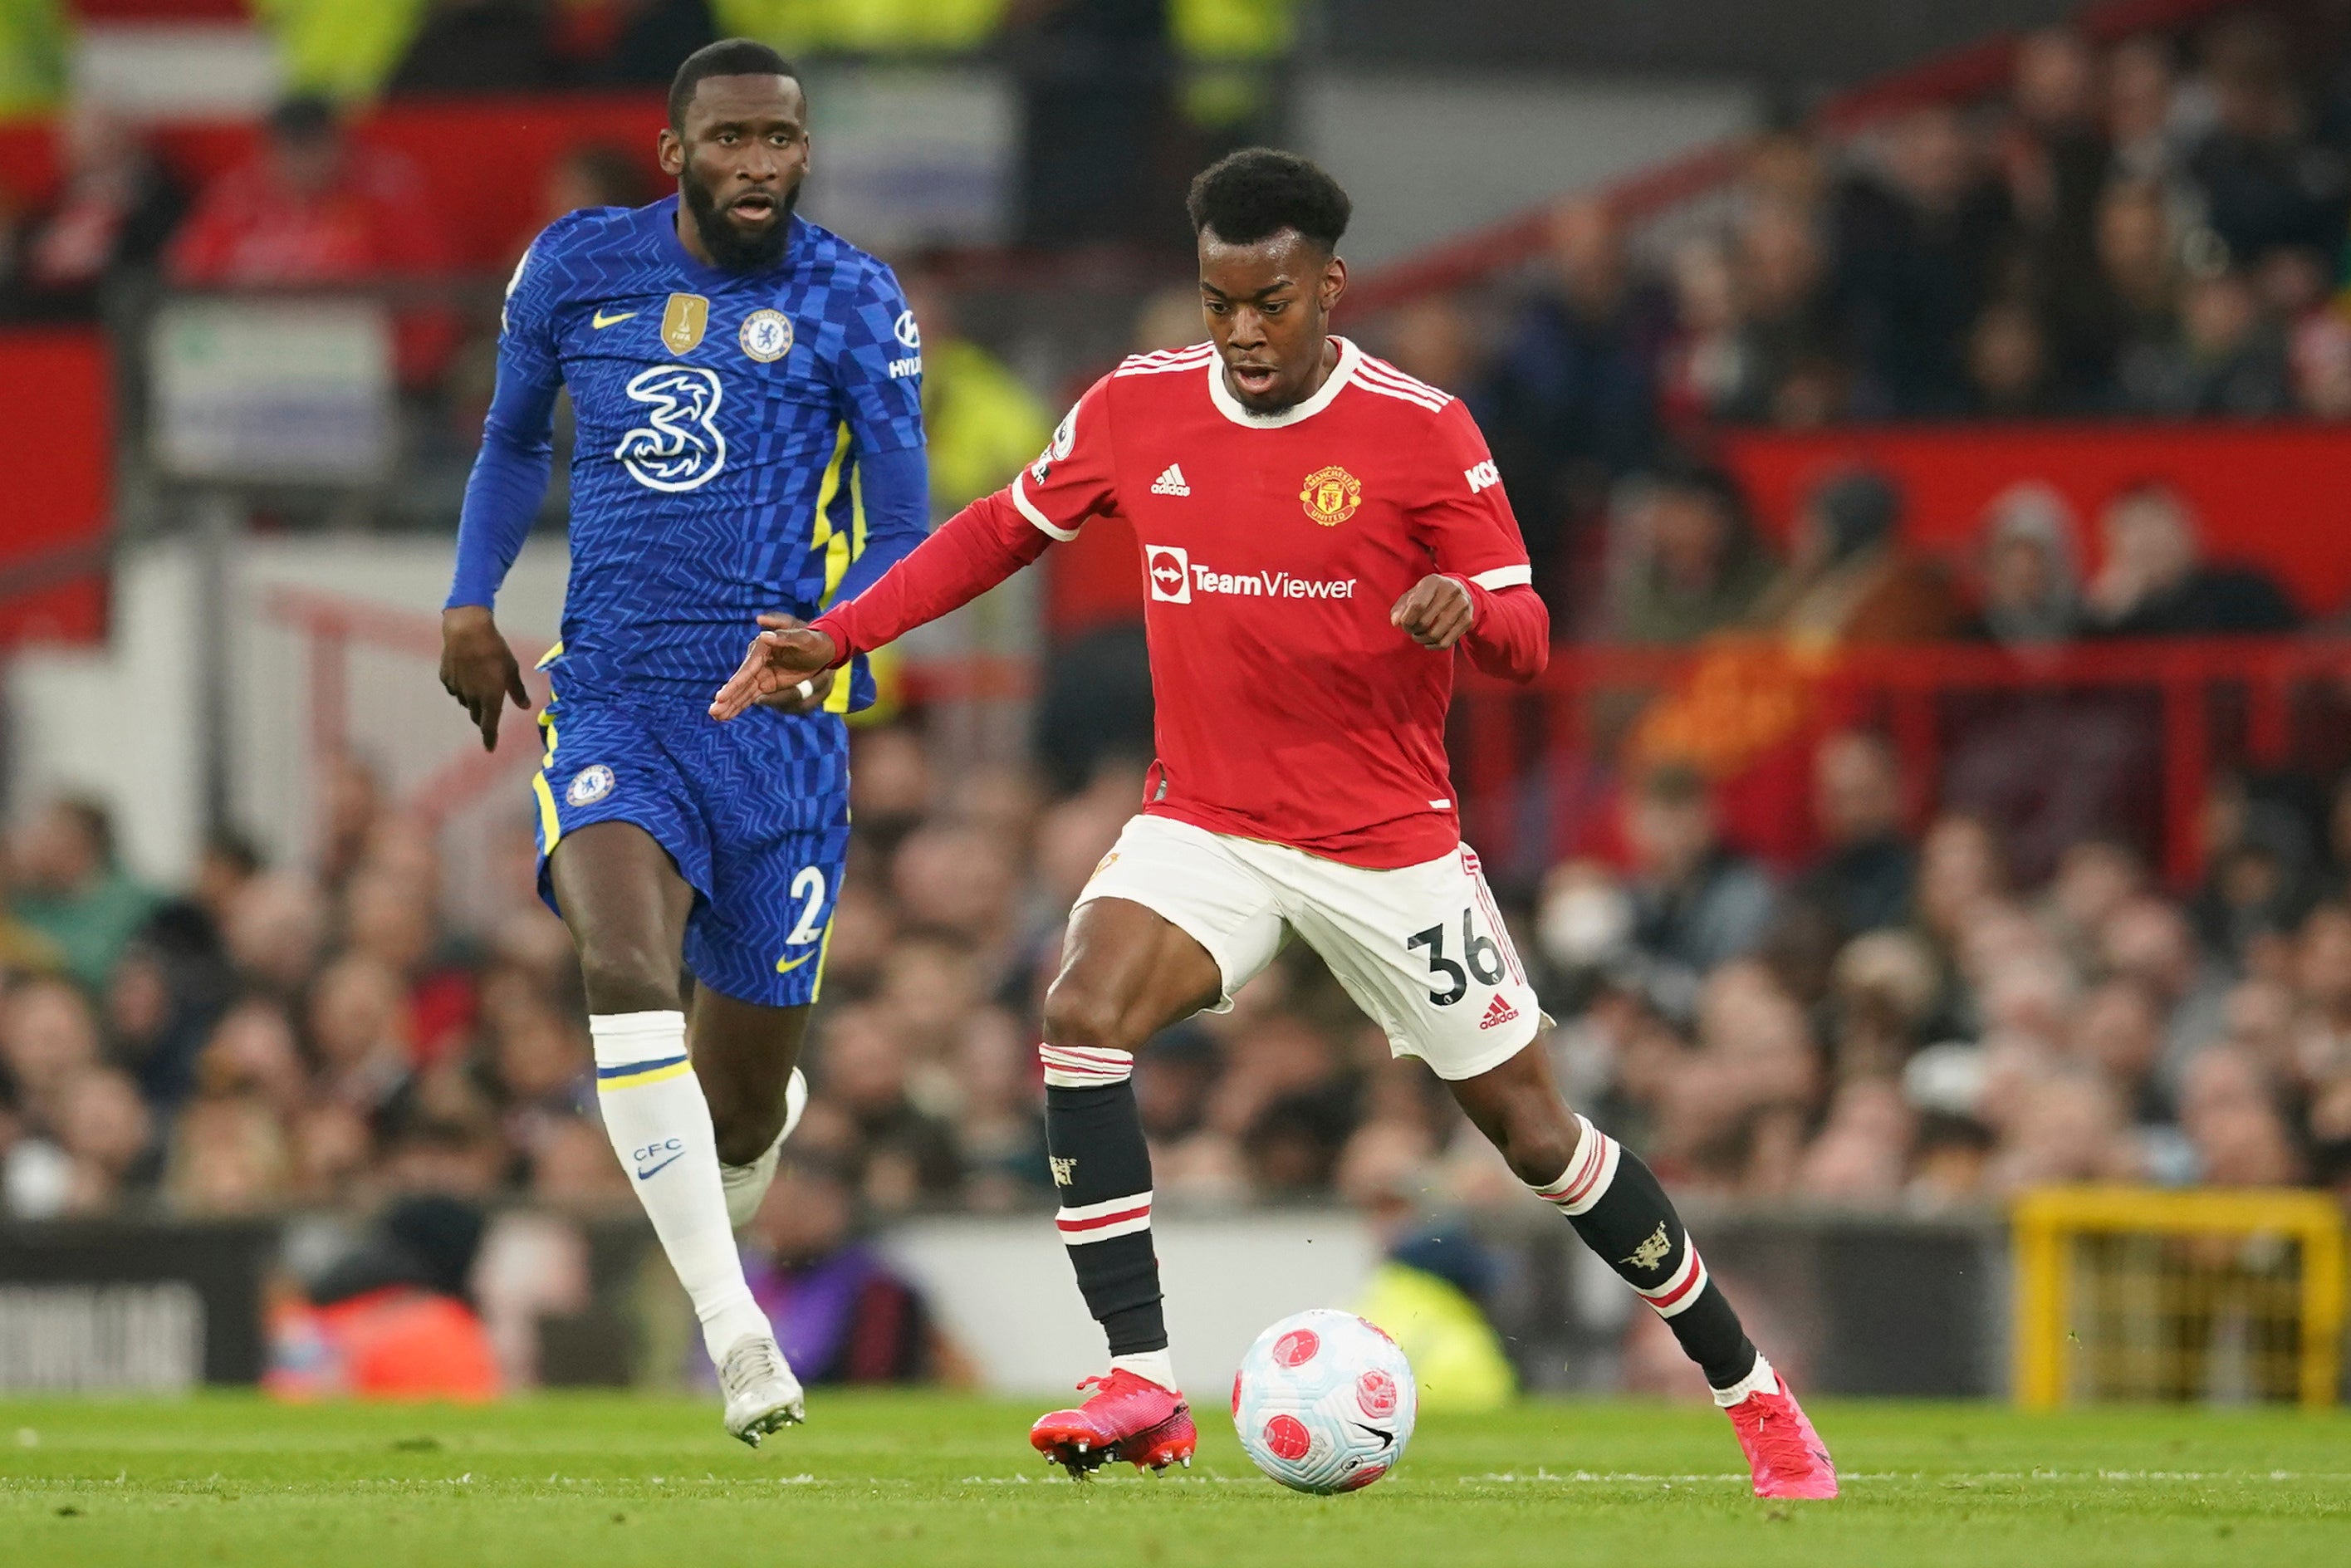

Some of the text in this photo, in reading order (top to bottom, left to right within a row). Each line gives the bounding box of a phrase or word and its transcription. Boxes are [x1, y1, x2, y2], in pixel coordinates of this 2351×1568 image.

[1150, 482, 1191, 497] adidas
[1308, 470, 1358, 492] MANCHESTER
[1310, 509, 1345, 522] UNITED
[1190, 564, 1357, 599] TeamViewer
[785, 865, 825, 945] 2
[1407, 907, 1506, 1007] 36
[1479, 1008, 1519, 1030] adidas
[634, 1138, 682, 1161] CFC
